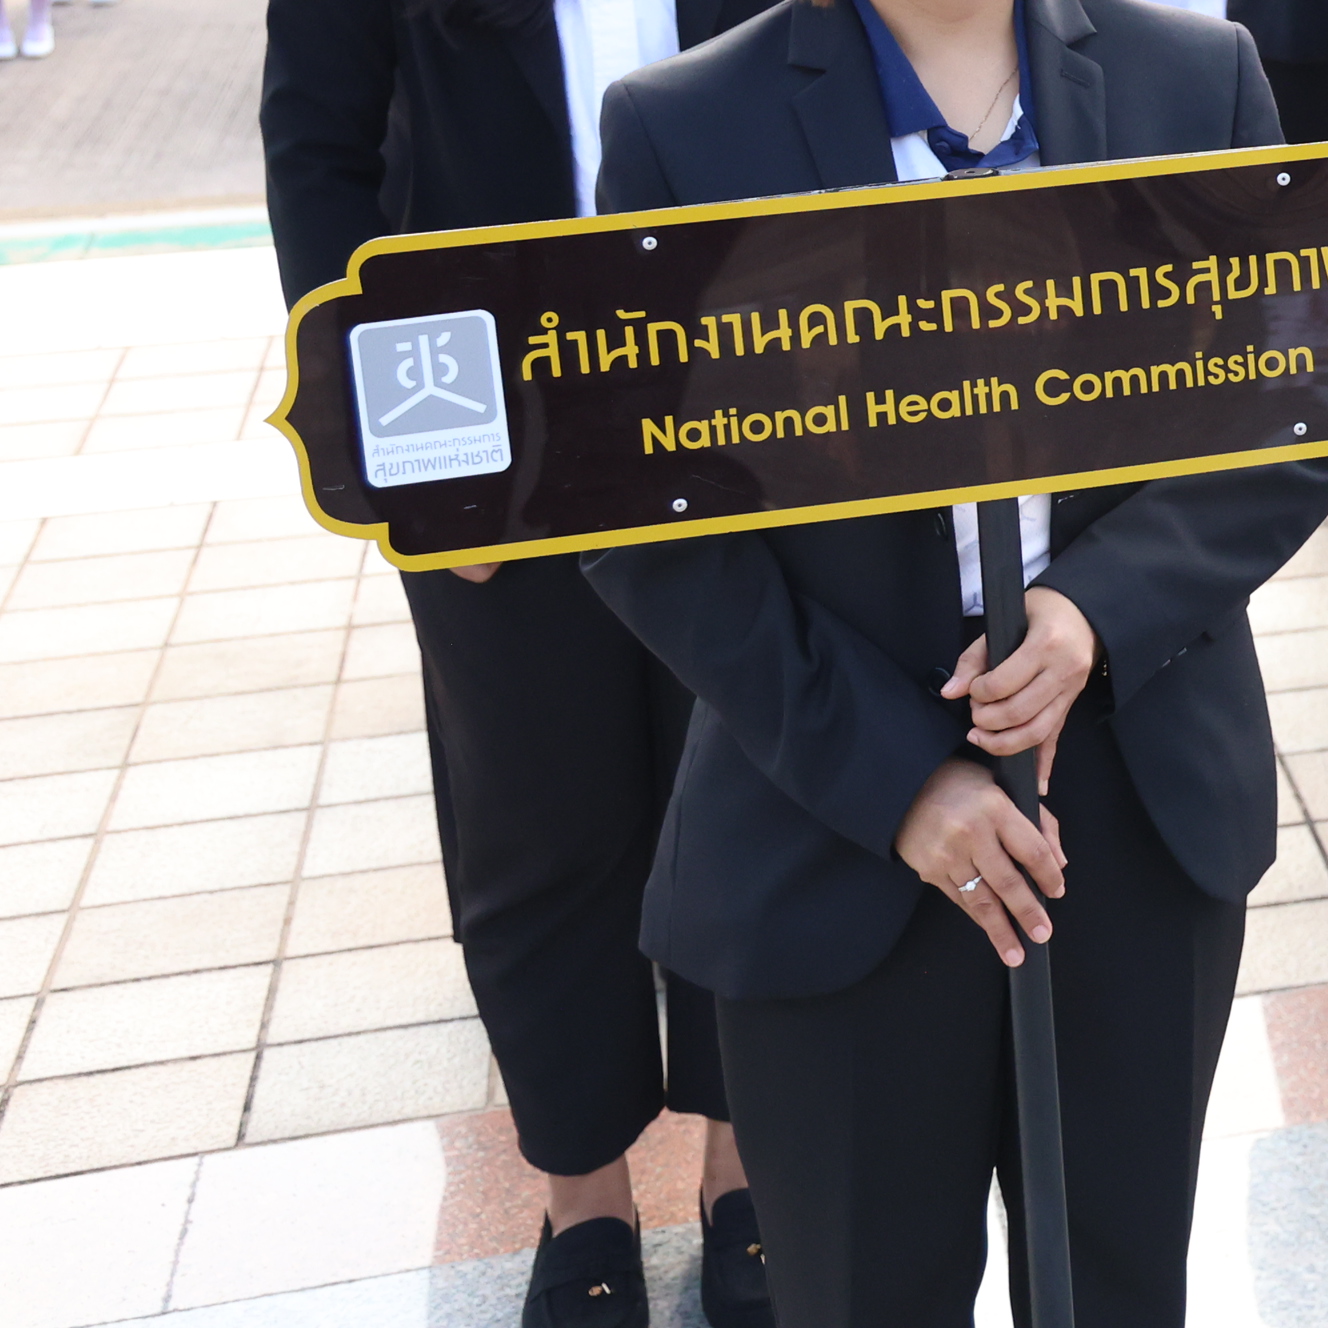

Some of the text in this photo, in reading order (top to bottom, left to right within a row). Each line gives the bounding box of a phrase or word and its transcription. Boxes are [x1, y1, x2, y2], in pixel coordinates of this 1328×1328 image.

[641, 395, 849, 454] National
[866, 376, 1019, 428] Health
[1035, 344, 1314, 406] Commission
[372, 432, 502, 458] สำนักงานคณะกรรมการ
[374, 445, 504, 483] สุขภาพแห่งชาติ
